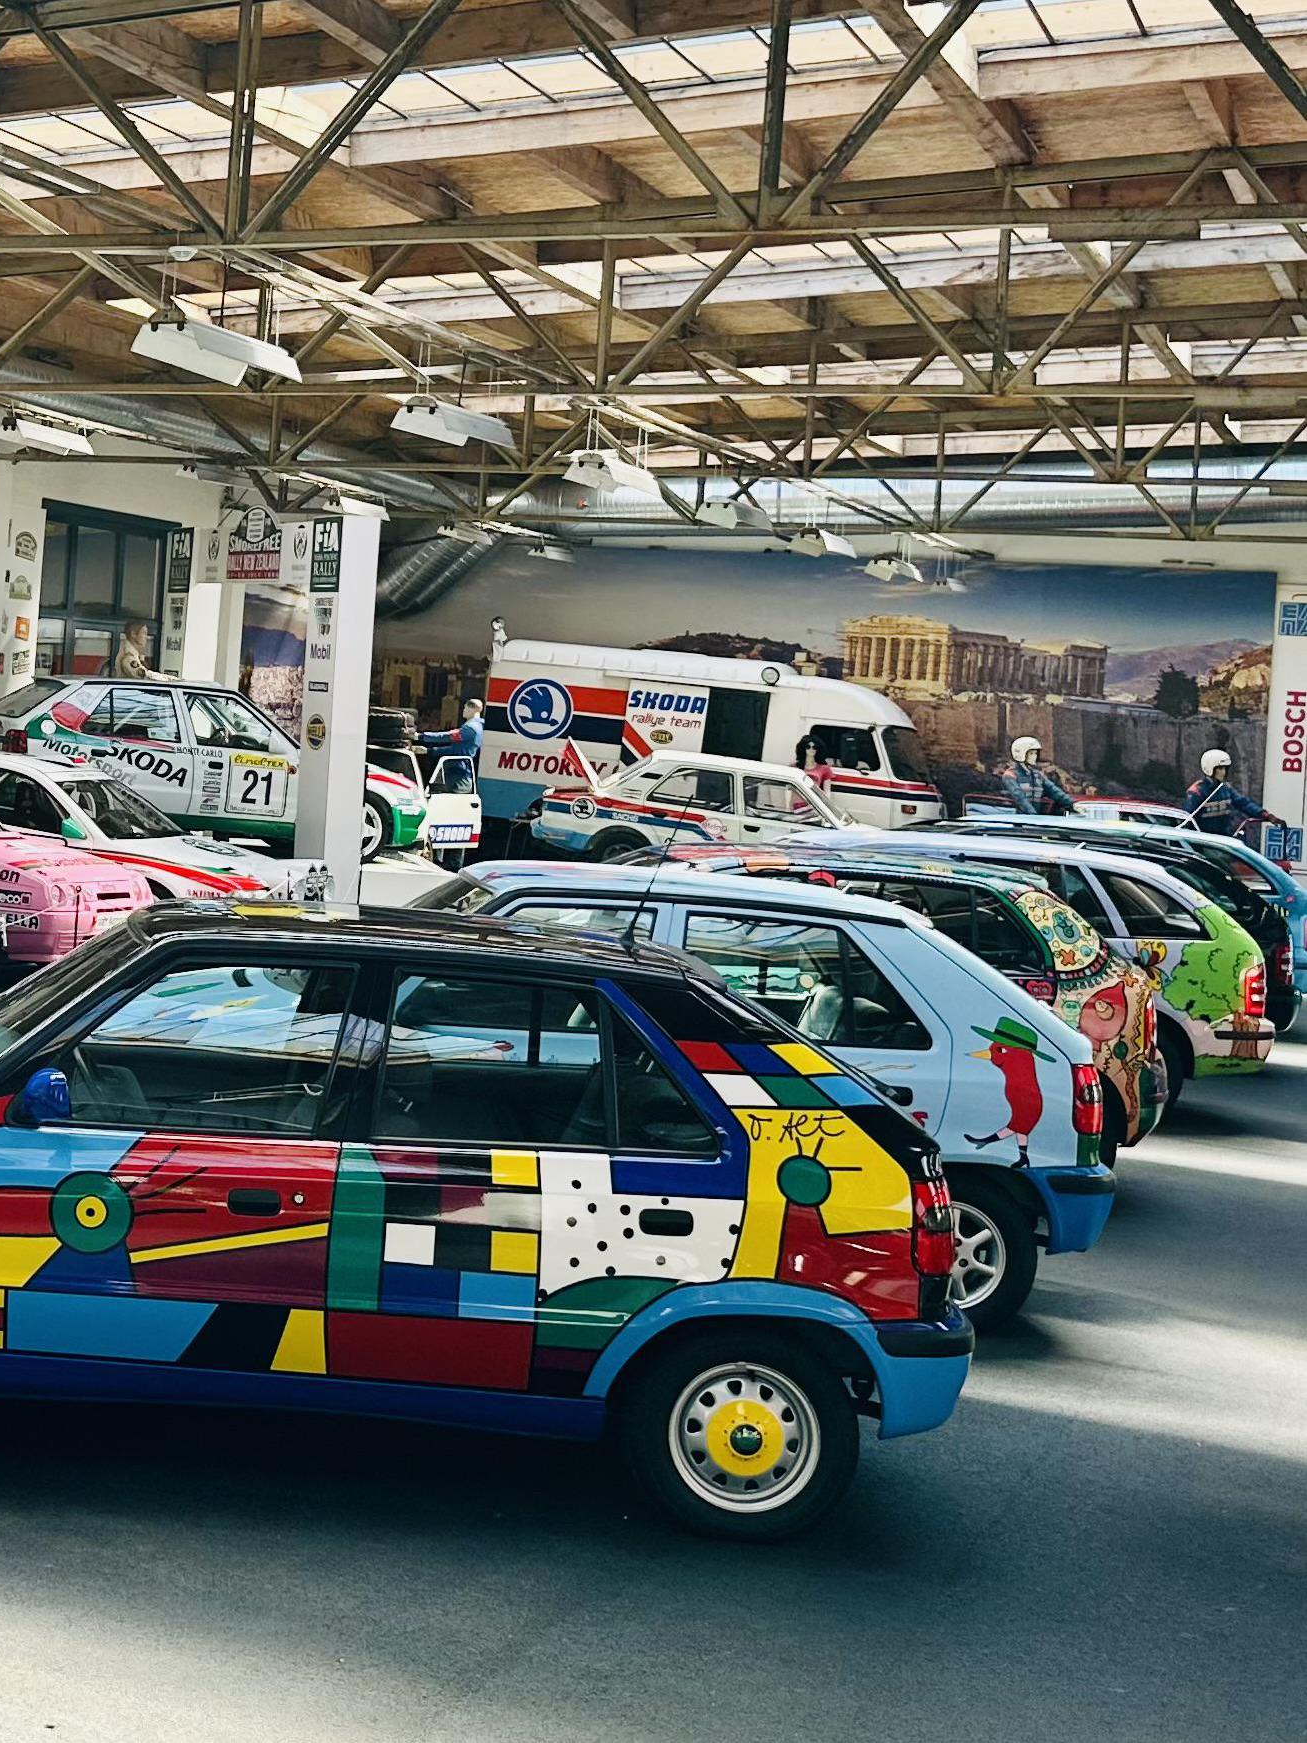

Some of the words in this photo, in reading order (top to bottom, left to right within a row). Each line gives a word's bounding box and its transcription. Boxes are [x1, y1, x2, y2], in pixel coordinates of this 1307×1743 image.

[228, 531, 282, 552] SMOKEFREE
[310, 643, 332, 660] Mobil
[628, 690, 708, 715] SKODA
[631, 713, 666, 728] rallye
[670, 715, 703, 729] team
[1281, 690, 1307, 773] BOSCH
[241, 769, 273, 806] 21
[611, 811, 639, 823] SACHS
[5, 912, 39, 930] ELLA
